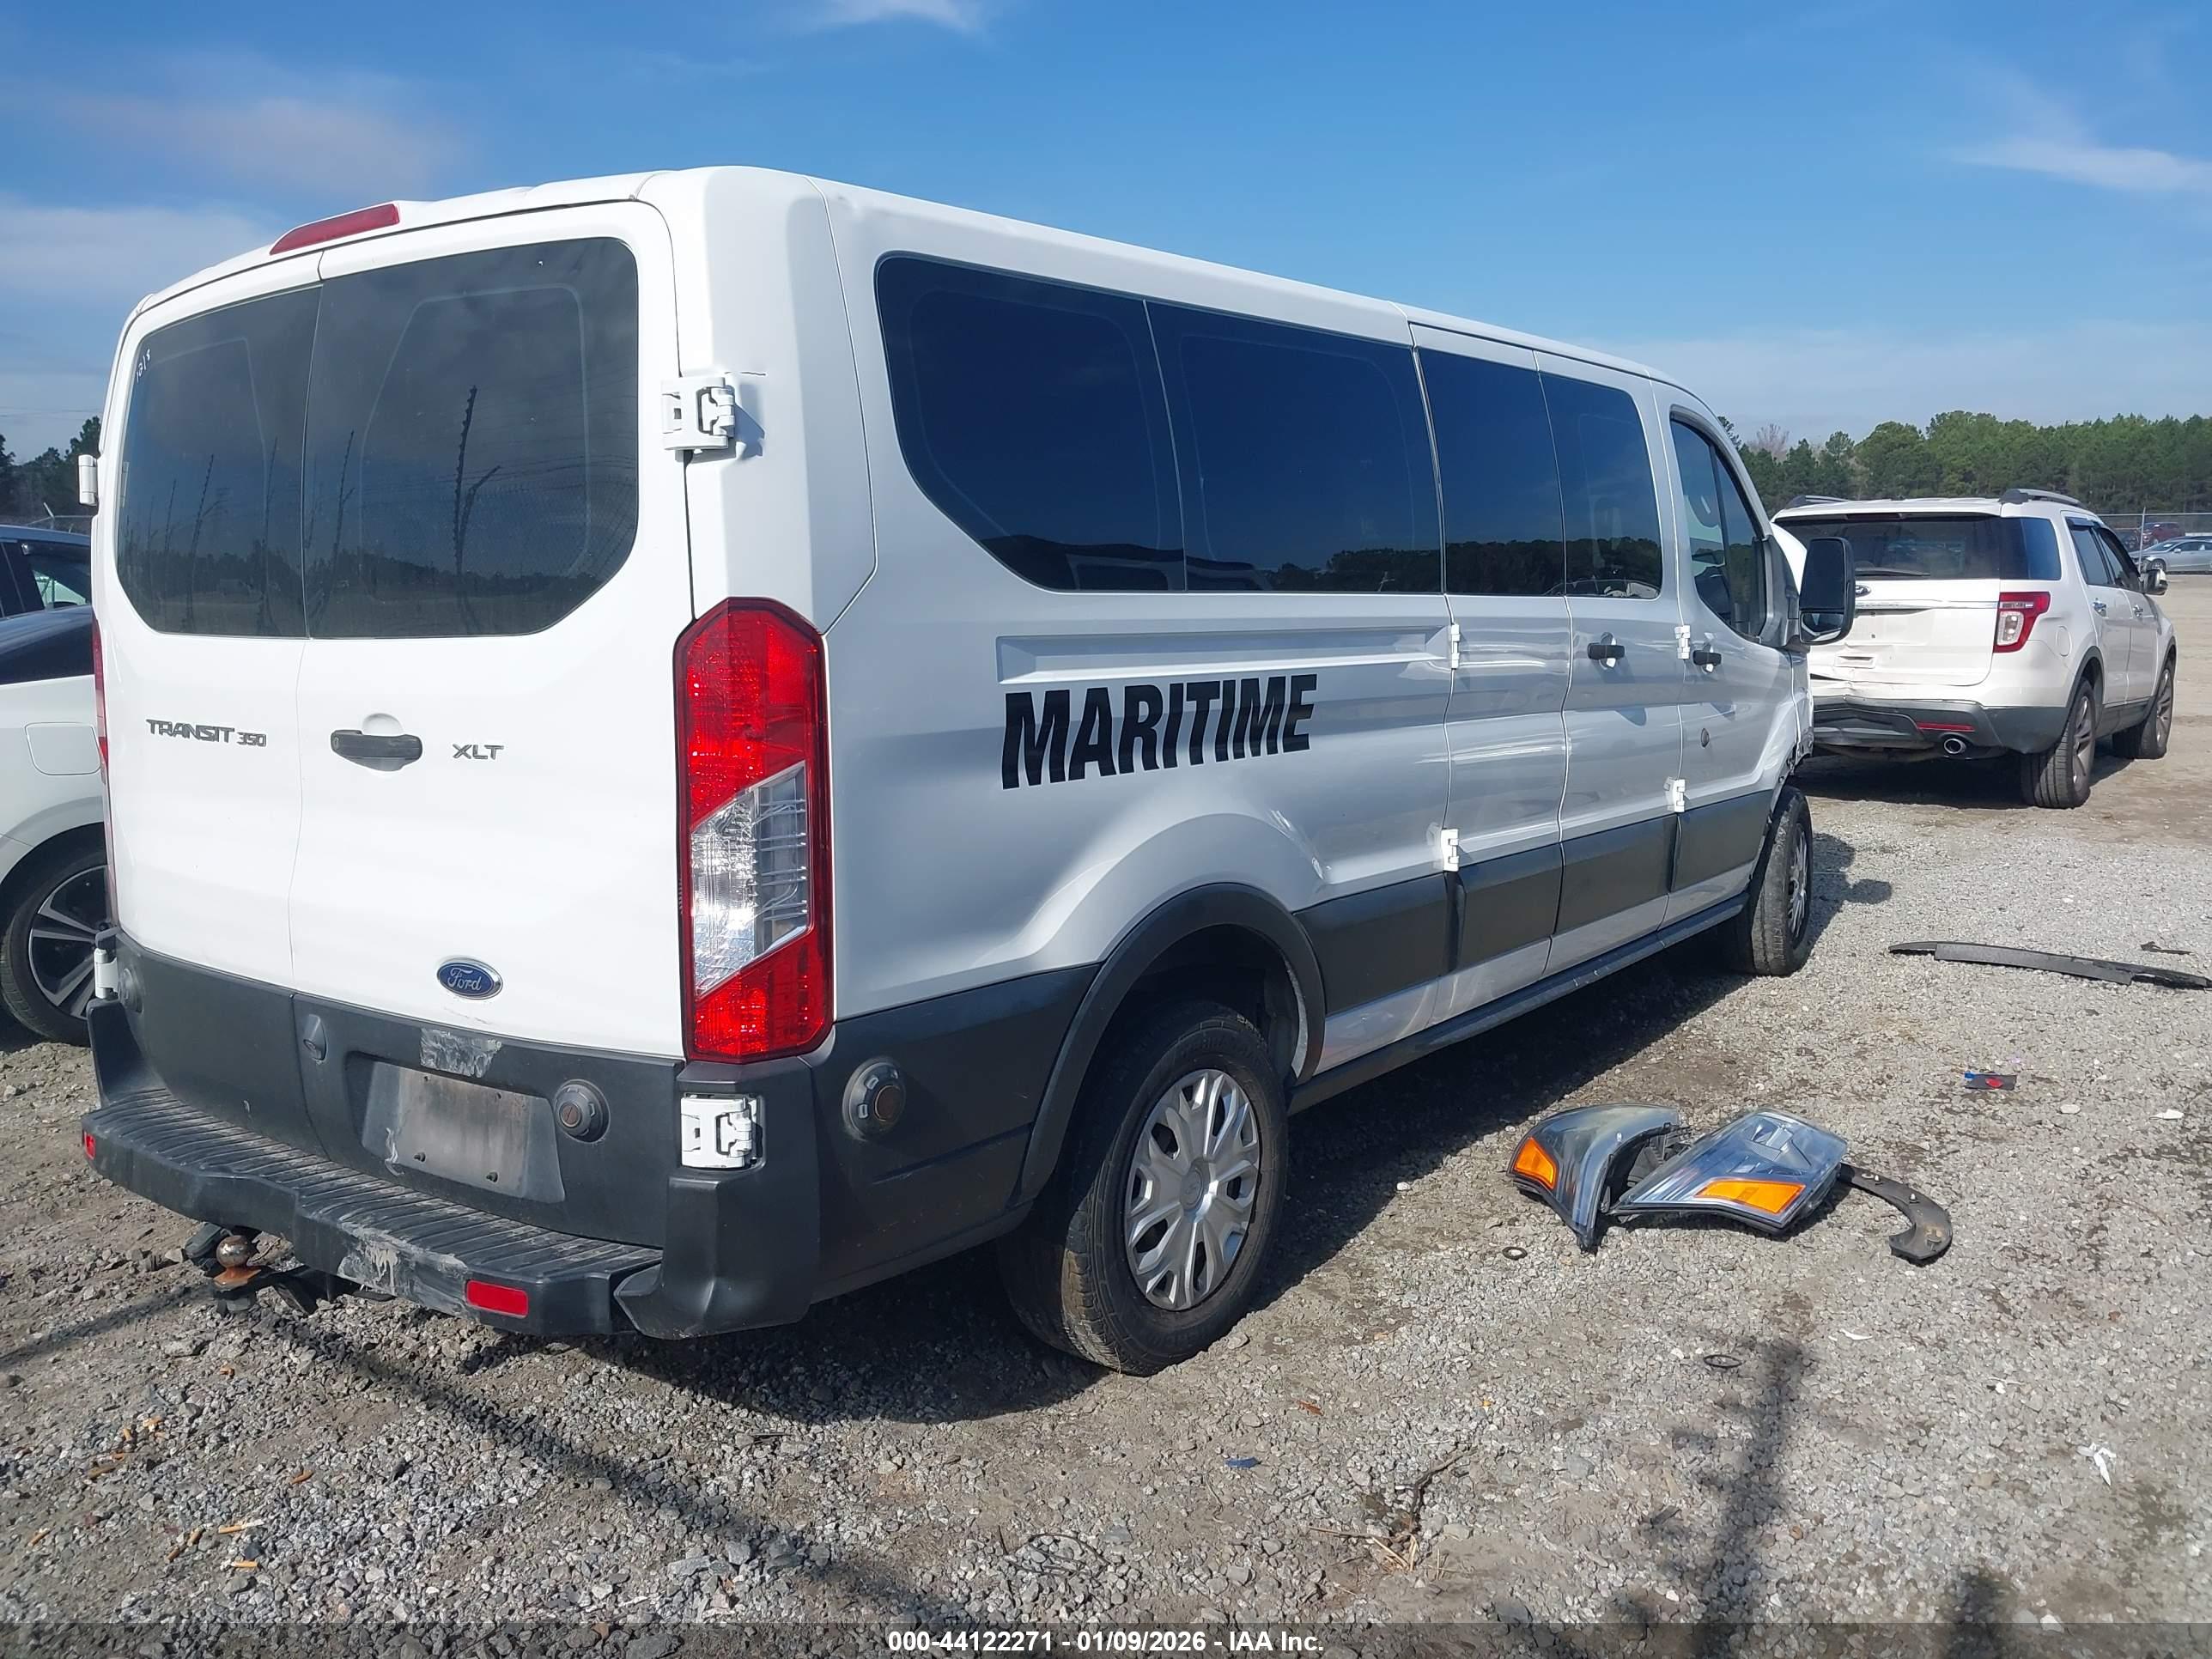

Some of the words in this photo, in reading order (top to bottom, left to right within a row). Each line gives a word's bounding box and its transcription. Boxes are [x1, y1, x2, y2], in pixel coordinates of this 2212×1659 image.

[145, 718, 235, 744] TRANSIT
[236, 731, 268, 748] 350
[1001, 673, 1318, 790] MARITIME
[452, 743, 505, 761] XLT
[447, 967, 483, 991] Ford
